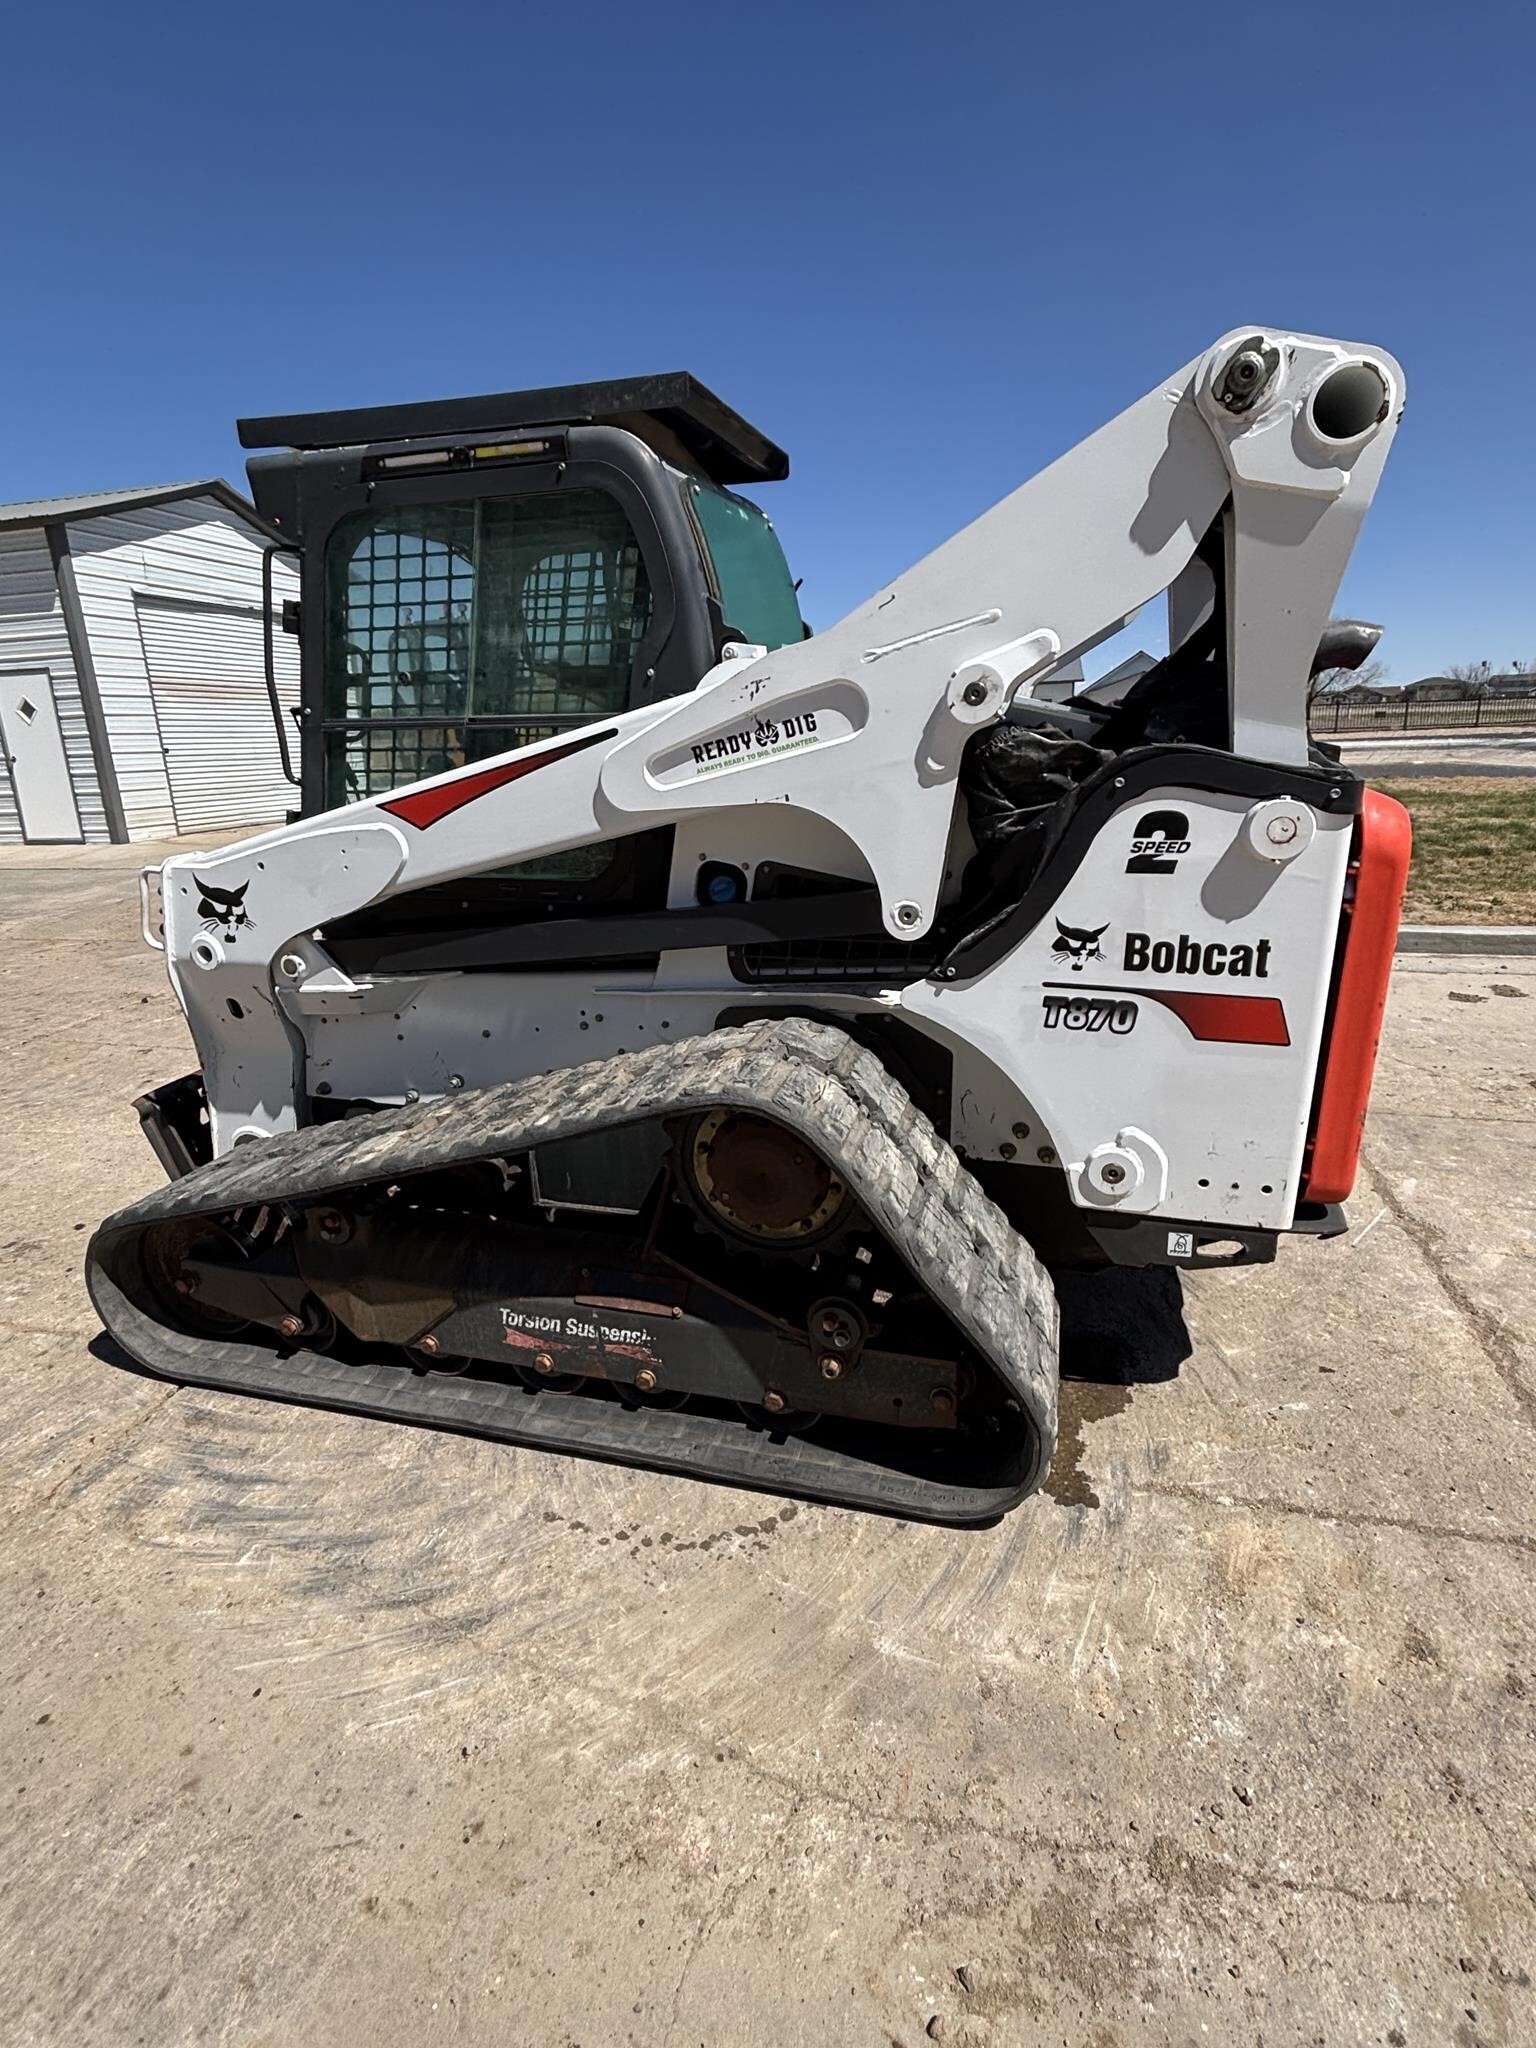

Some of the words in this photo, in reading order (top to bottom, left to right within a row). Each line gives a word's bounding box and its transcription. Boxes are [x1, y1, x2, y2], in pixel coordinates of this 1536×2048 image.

[691, 730, 752, 764] READY
[782, 713, 818, 739] DIG
[696, 761, 723, 775] ALWAYS
[723, 756, 746, 768] READY
[746, 753, 757, 761] TO
[1125, 810, 1189, 874] 2
[1130, 841, 1191, 853] SPEED
[1123, 932, 1271, 978] Bobcat
[1042, 995, 1139, 1035] T870
[499, 1308, 561, 1333] Torsion
